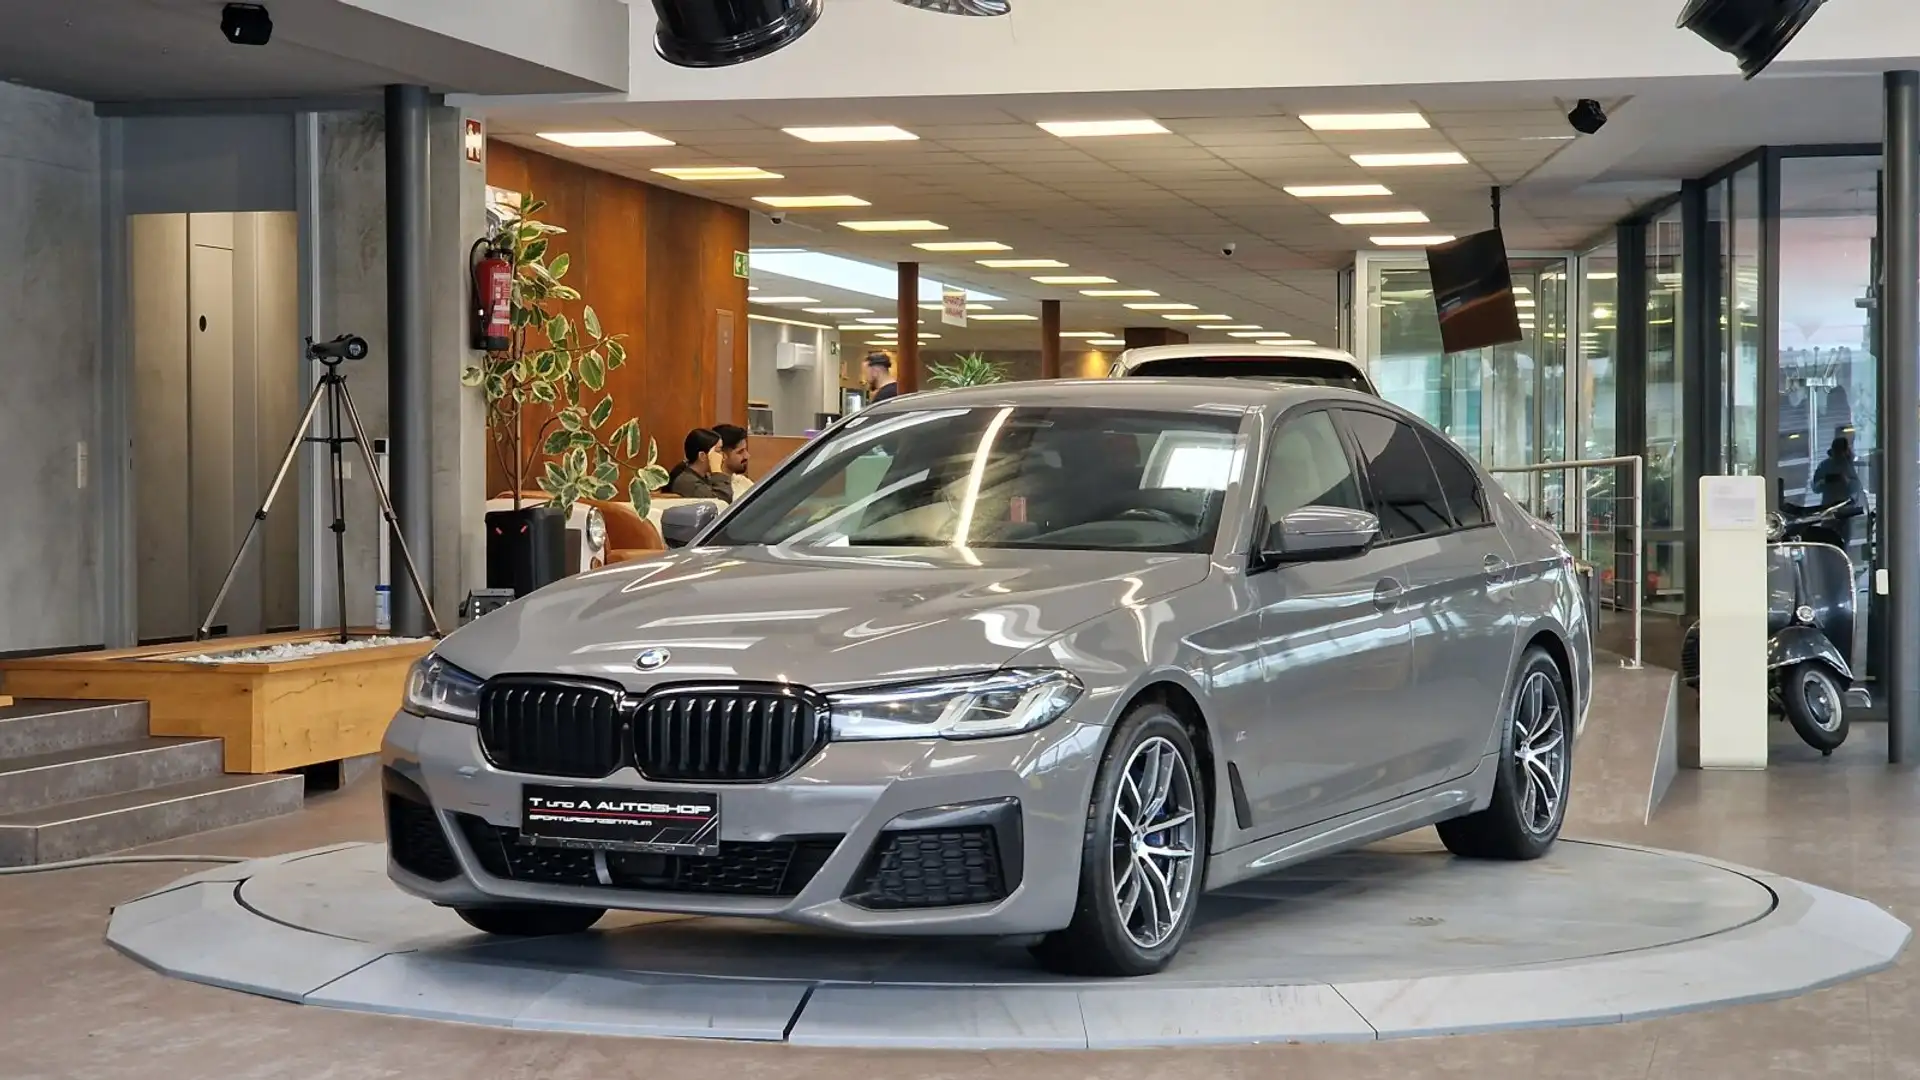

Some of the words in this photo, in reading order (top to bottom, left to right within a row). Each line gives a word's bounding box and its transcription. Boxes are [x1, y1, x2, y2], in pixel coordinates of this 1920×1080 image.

[529, 797, 543, 807] T
[578, 800, 592, 810] A
[596, 801, 711, 814] AUTOSHOP
